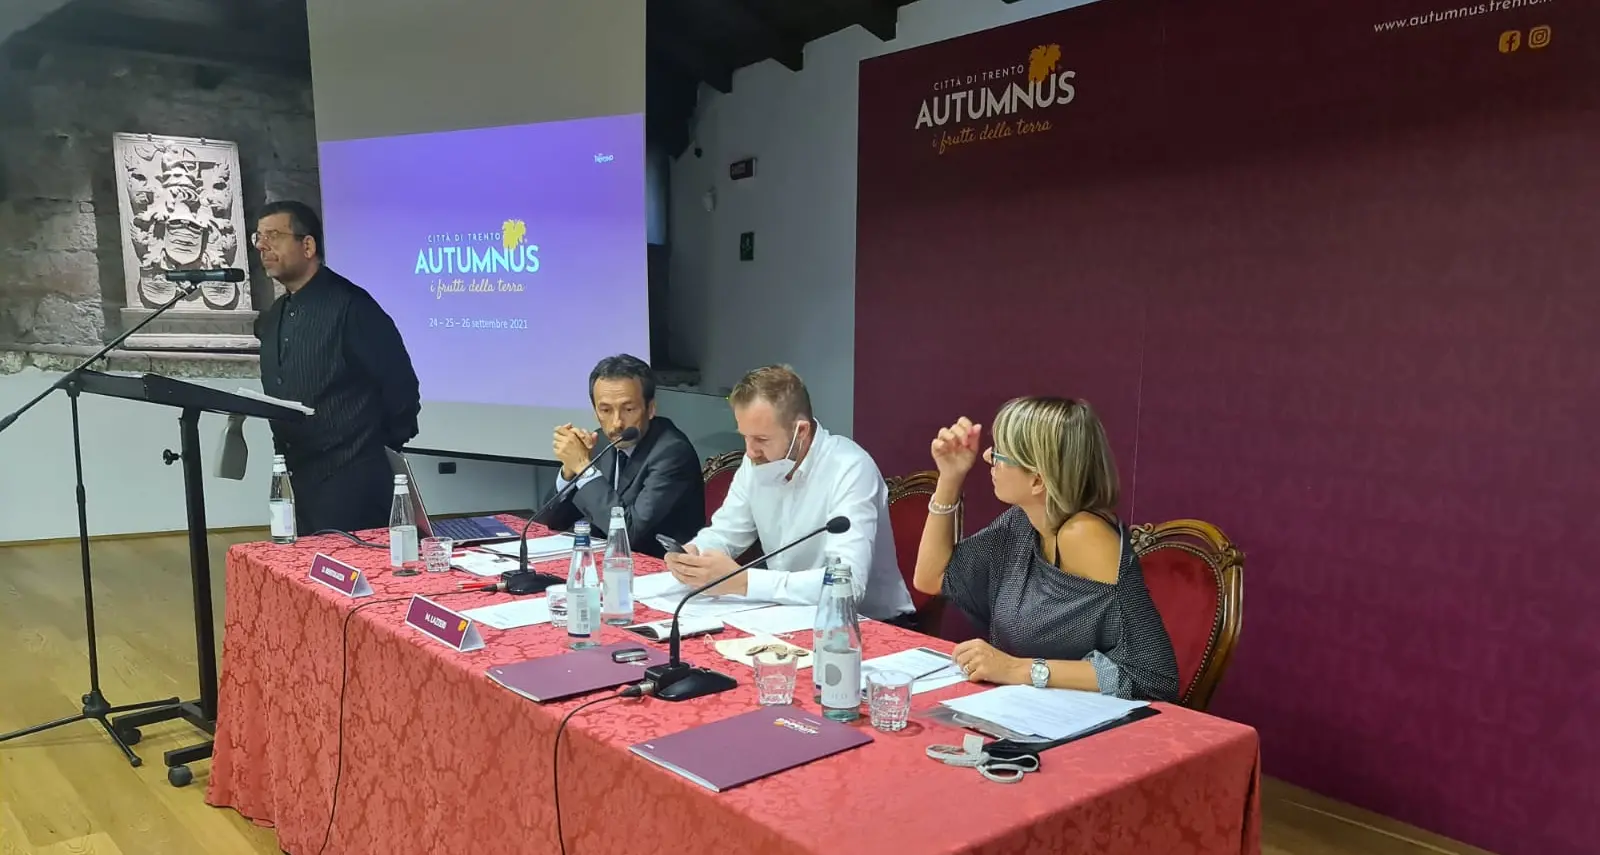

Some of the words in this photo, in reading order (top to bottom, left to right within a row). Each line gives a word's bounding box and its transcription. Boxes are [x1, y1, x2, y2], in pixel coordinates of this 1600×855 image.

[933, 77, 962, 91] CITTÀ
[966, 75, 977, 85] DI
[982, 64, 1024, 80] TRENTO
[914, 71, 1076, 130] AUTUMNUS
[939, 127, 976, 155] frutti
[979, 121, 1012, 141] della
[1016, 118, 1052, 135] terra
[427, 233, 451, 243] CITTÀ
[467, 232, 501, 241] TRENTO
[415, 244, 539, 274] AUTUMNUS
[436, 279, 466, 300] frutti
[468, 279, 495, 292] della
[497, 279, 525, 292] terra
[428, 318, 438, 328] 24
[445, 318, 454, 328] 25
[461, 318, 471, 328] 26
[471, 318, 508, 329] settembre
[509, 318, 529, 329] 2021
